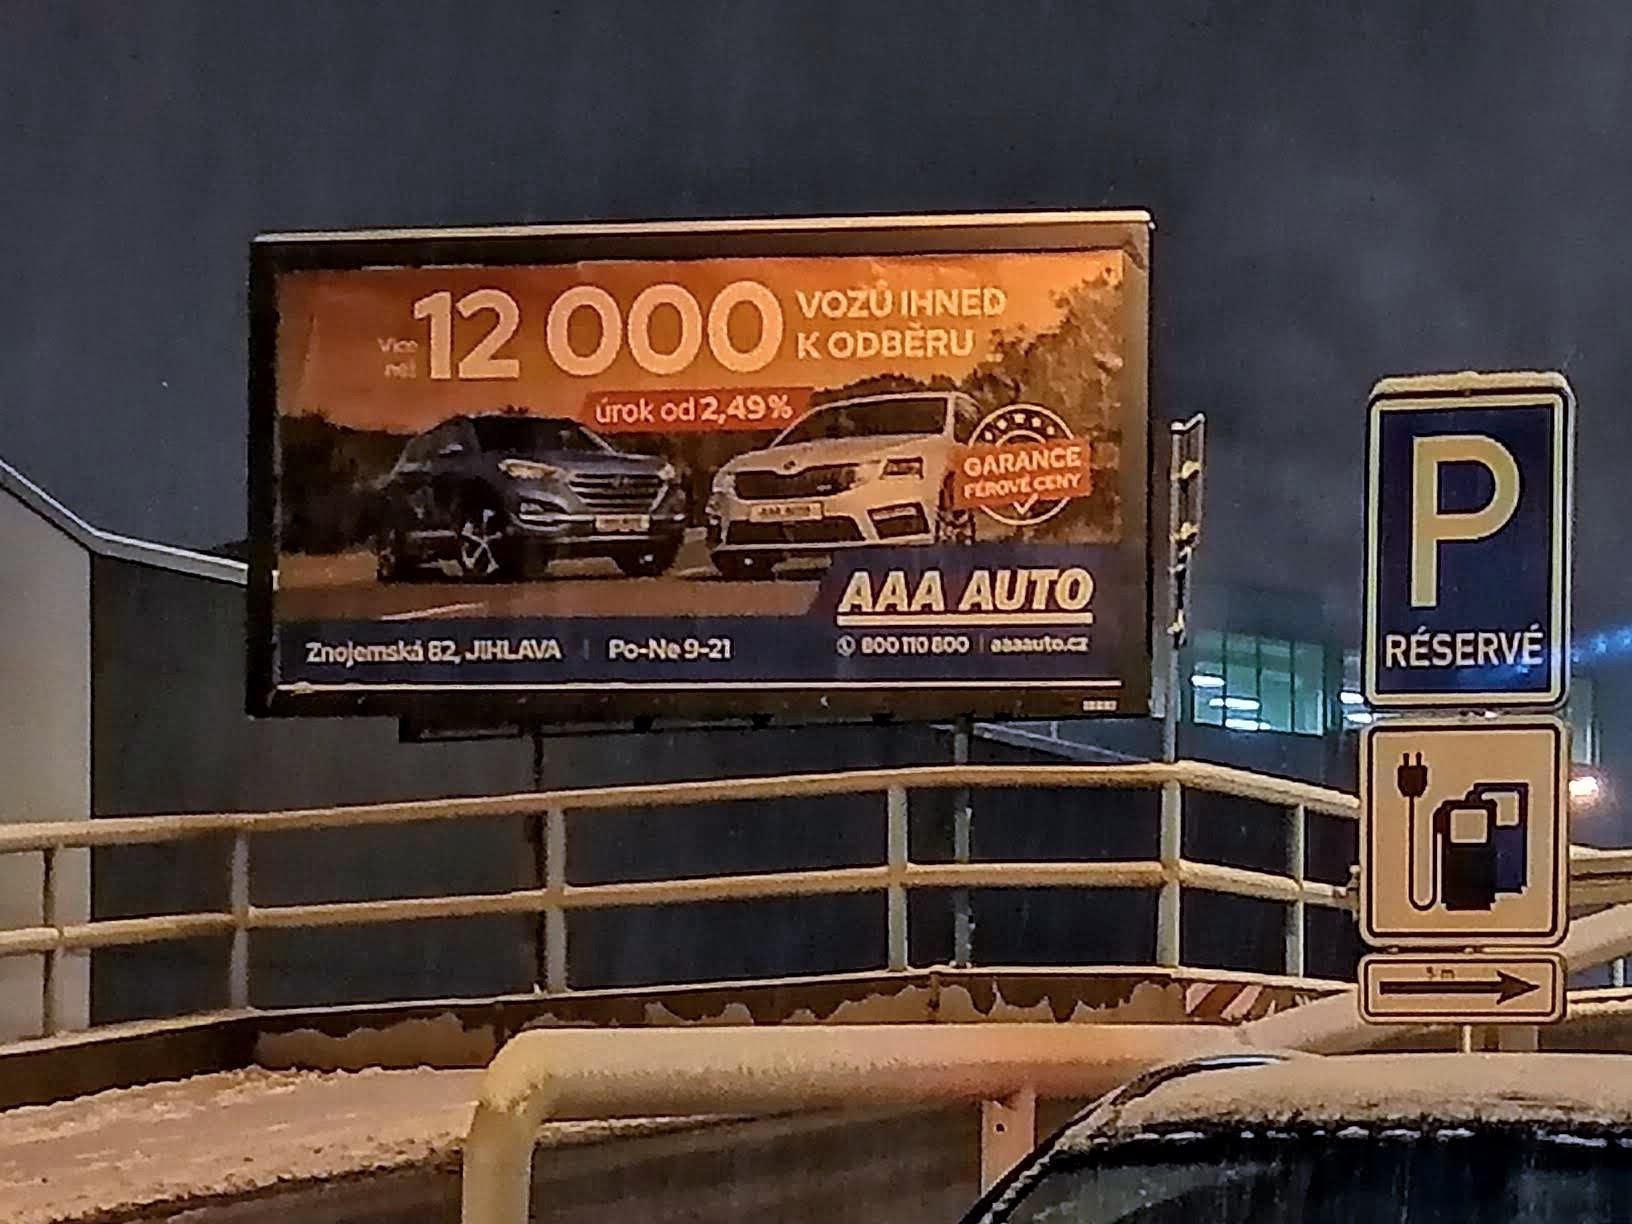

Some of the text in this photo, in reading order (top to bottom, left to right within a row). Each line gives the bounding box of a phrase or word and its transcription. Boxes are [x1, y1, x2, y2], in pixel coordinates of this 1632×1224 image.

[796, 278, 1007, 319] VOZŮ IHNED
[413, 280, 784, 380] 12 000
[797, 322, 974, 360] K ODBĚRU
[595, 397, 655, 424] úrok
[660, 397, 695, 422] od
[963, 445, 1083, 477] GARANCE
[1033, 470, 1082, 493] CENY
[1410, 434, 1522, 608] P
[837, 567, 1095, 614] AAA AUTO
[305, 639, 563, 668] Znojemská 82, JIHLAVA
[608, 638, 731, 660] Po-Ne 9-21
[861, 635, 1089, 654] 800 110 800 aaaauto.cz
[1385, 625, 1545, 670] RÉSERVÉ
